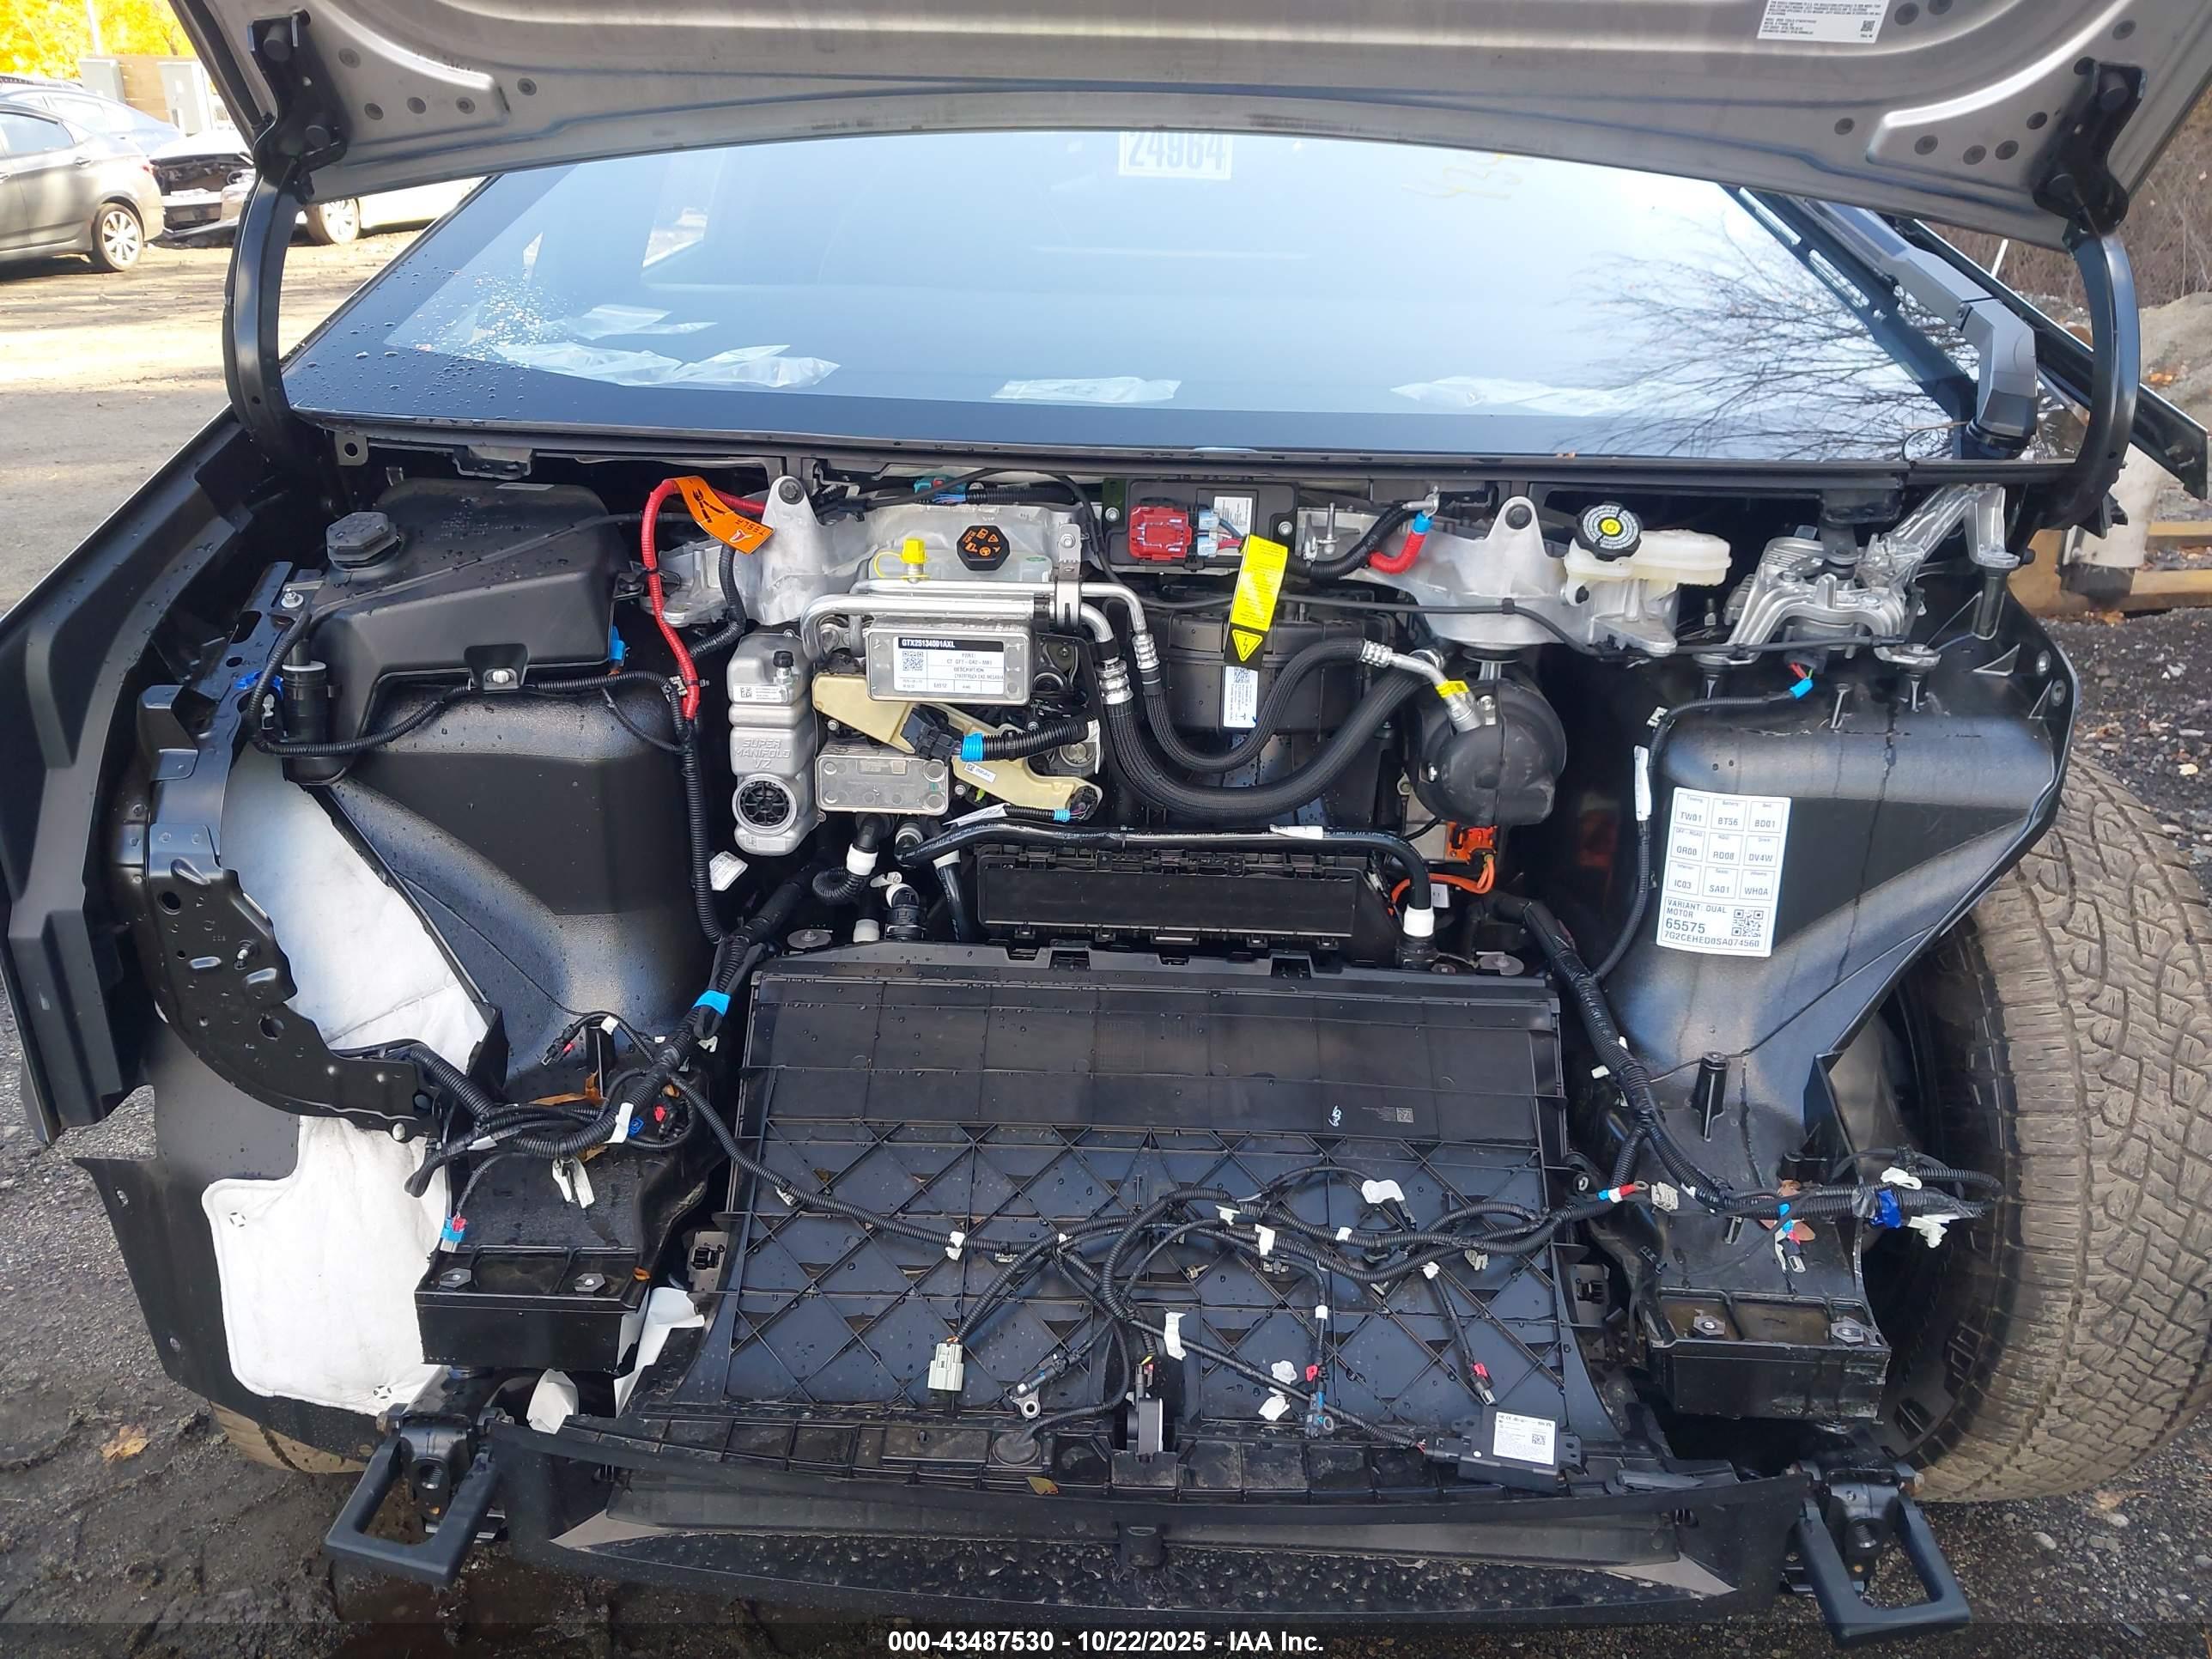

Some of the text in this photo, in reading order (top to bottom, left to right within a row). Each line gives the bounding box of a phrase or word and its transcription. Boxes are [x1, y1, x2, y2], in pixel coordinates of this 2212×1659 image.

[734, 518, 766, 537] TESLA
[741, 738, 782, 749] SUPER
[734, 748, 792, 759] MANIFOLD
[1680, 811, 1703, 823] TW01
[1717, 817, 1739, 826] BT56
[1754, 819, 1776, 829] BD01
[1712, 851, 1735, 860] RD08
[1748, 853, 1773, 862] DV4W
[1674, 878, 1692, 890] IC03
[1709, 884, 1729, 894] SA01
[1668, 899, 1728, 914] VARIANT: DUAL
[1666, 907, 1693, 918] MOTOR
[1665, 917, 1706, 934] 65575
